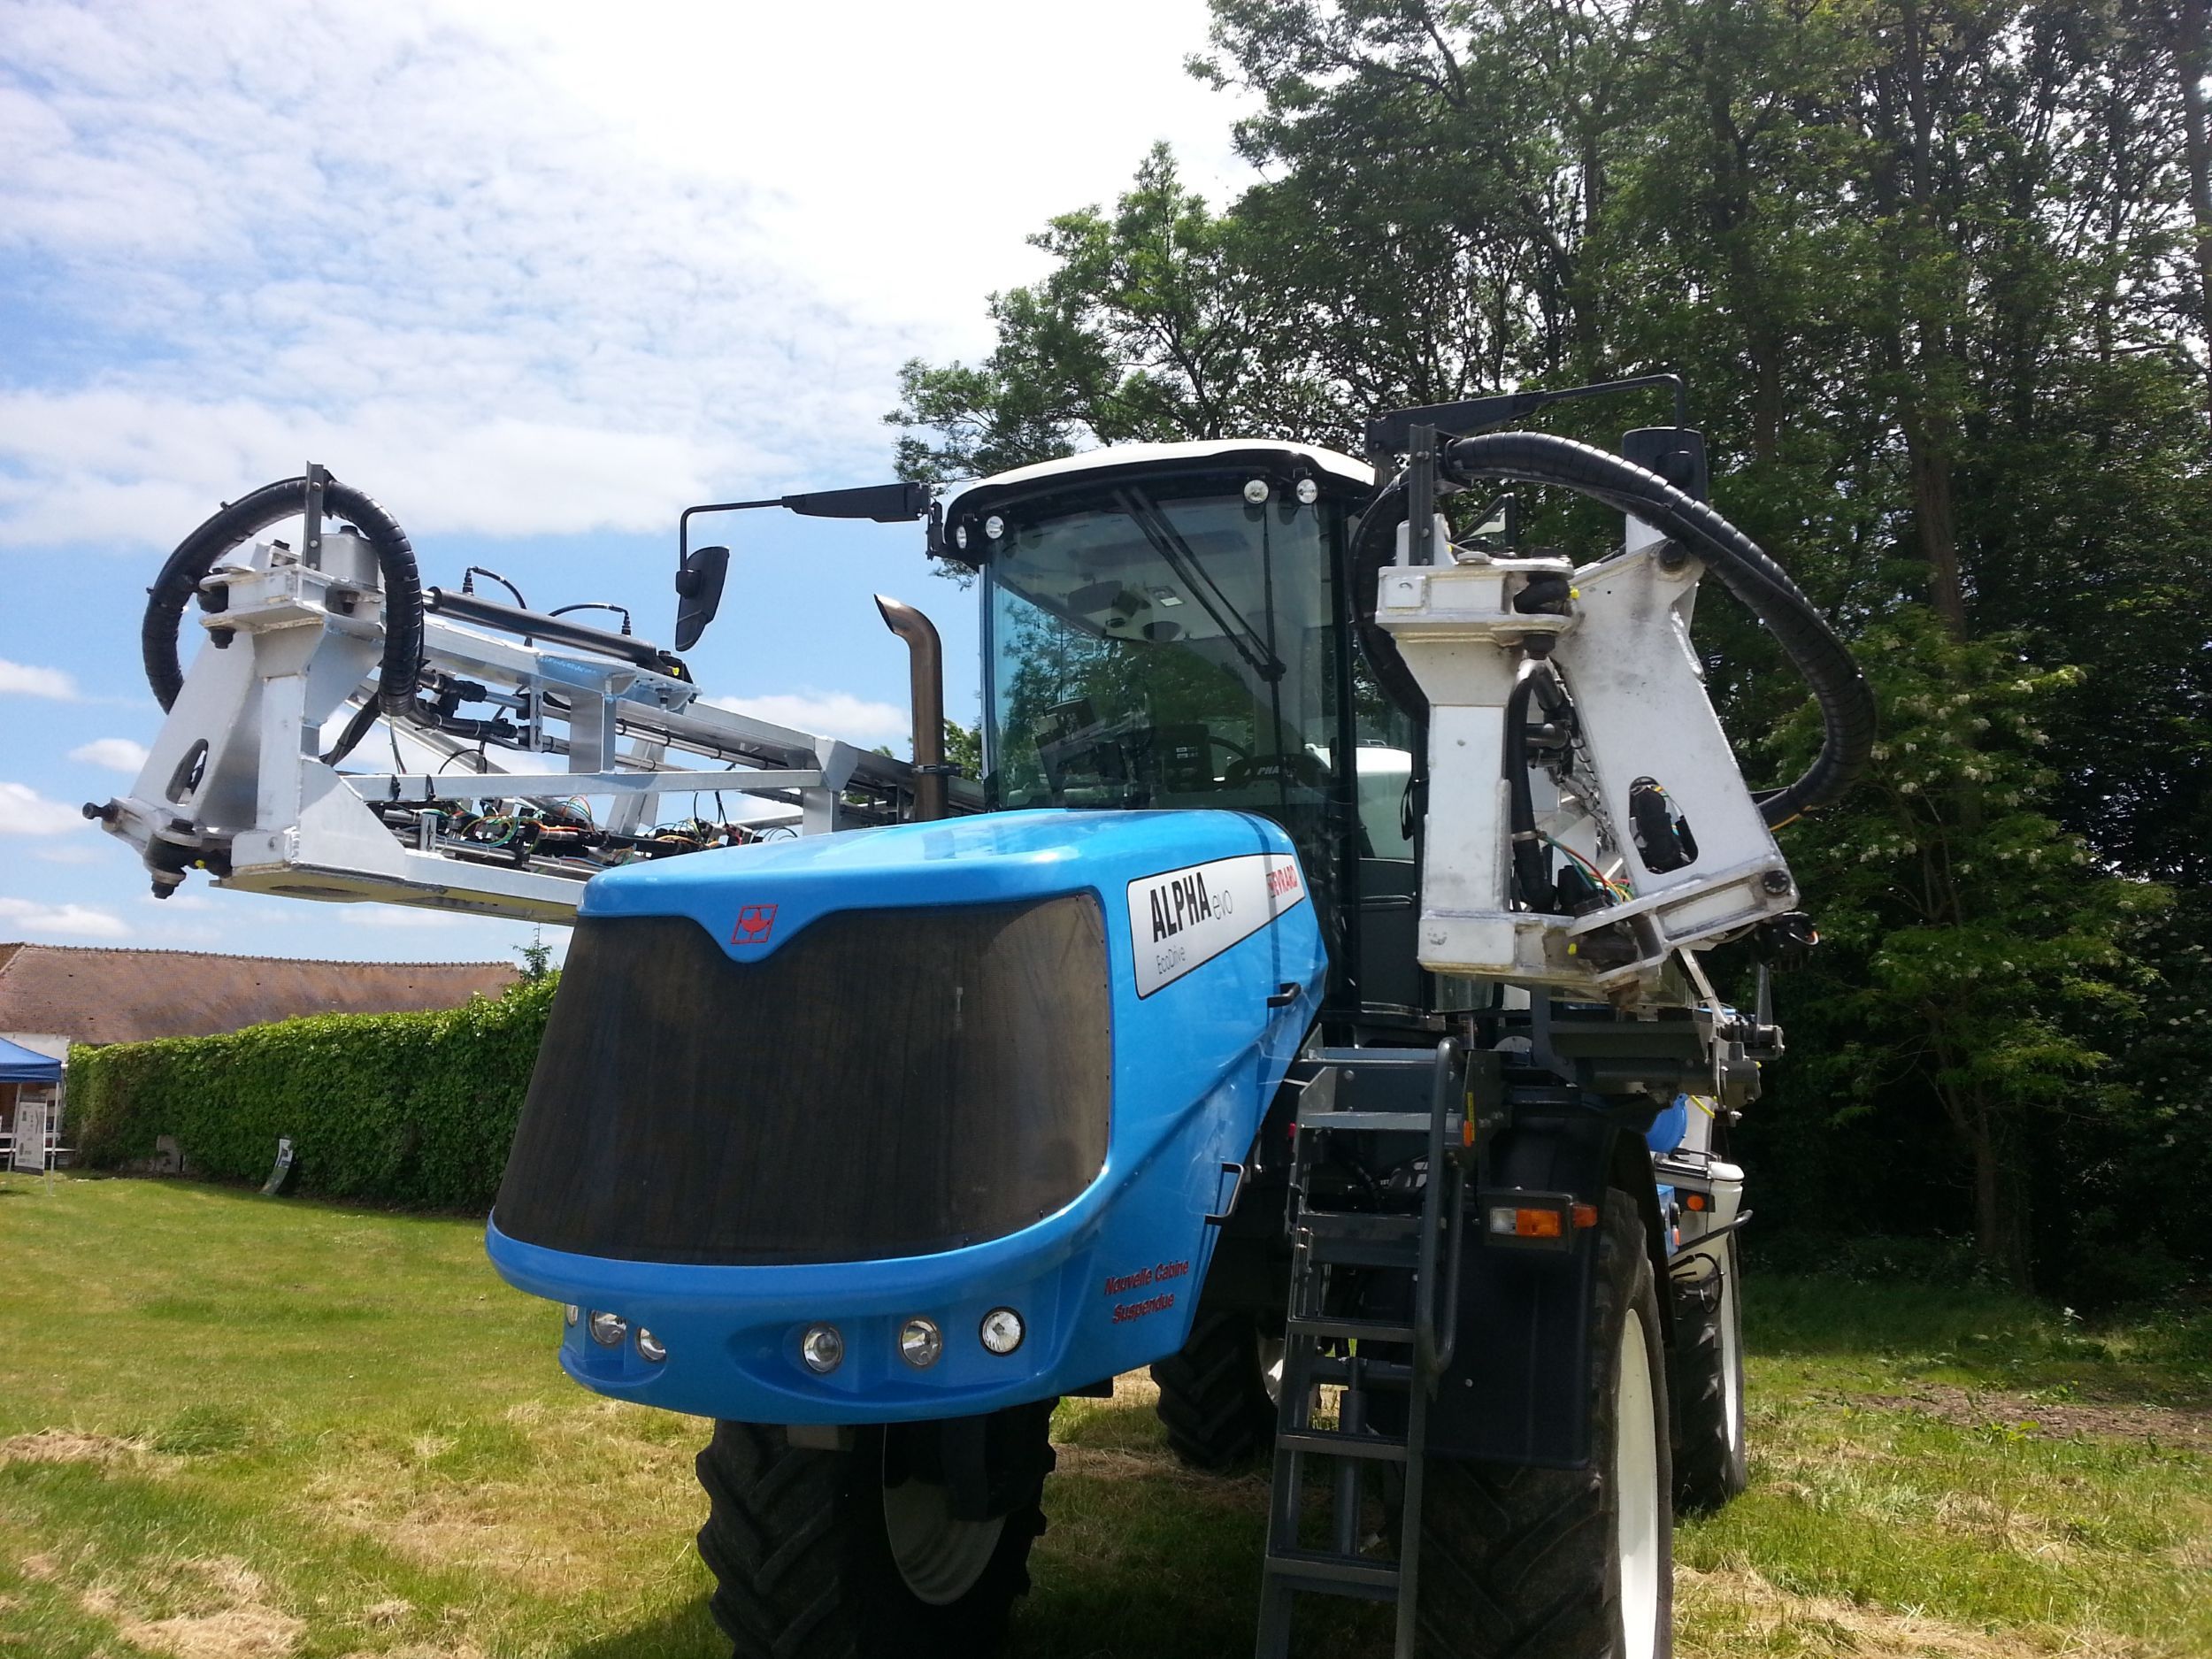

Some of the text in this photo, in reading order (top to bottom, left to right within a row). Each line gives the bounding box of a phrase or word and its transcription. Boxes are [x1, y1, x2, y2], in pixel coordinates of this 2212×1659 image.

[1150, 872, 1233, 943] ALPHA evo
[1156, 945, 1186, 975] EcoDrive
[1104, 1260, 1189, 1295] Nouvelle Cabine
[1112, 1294, 1175, 1324] Suspendue
